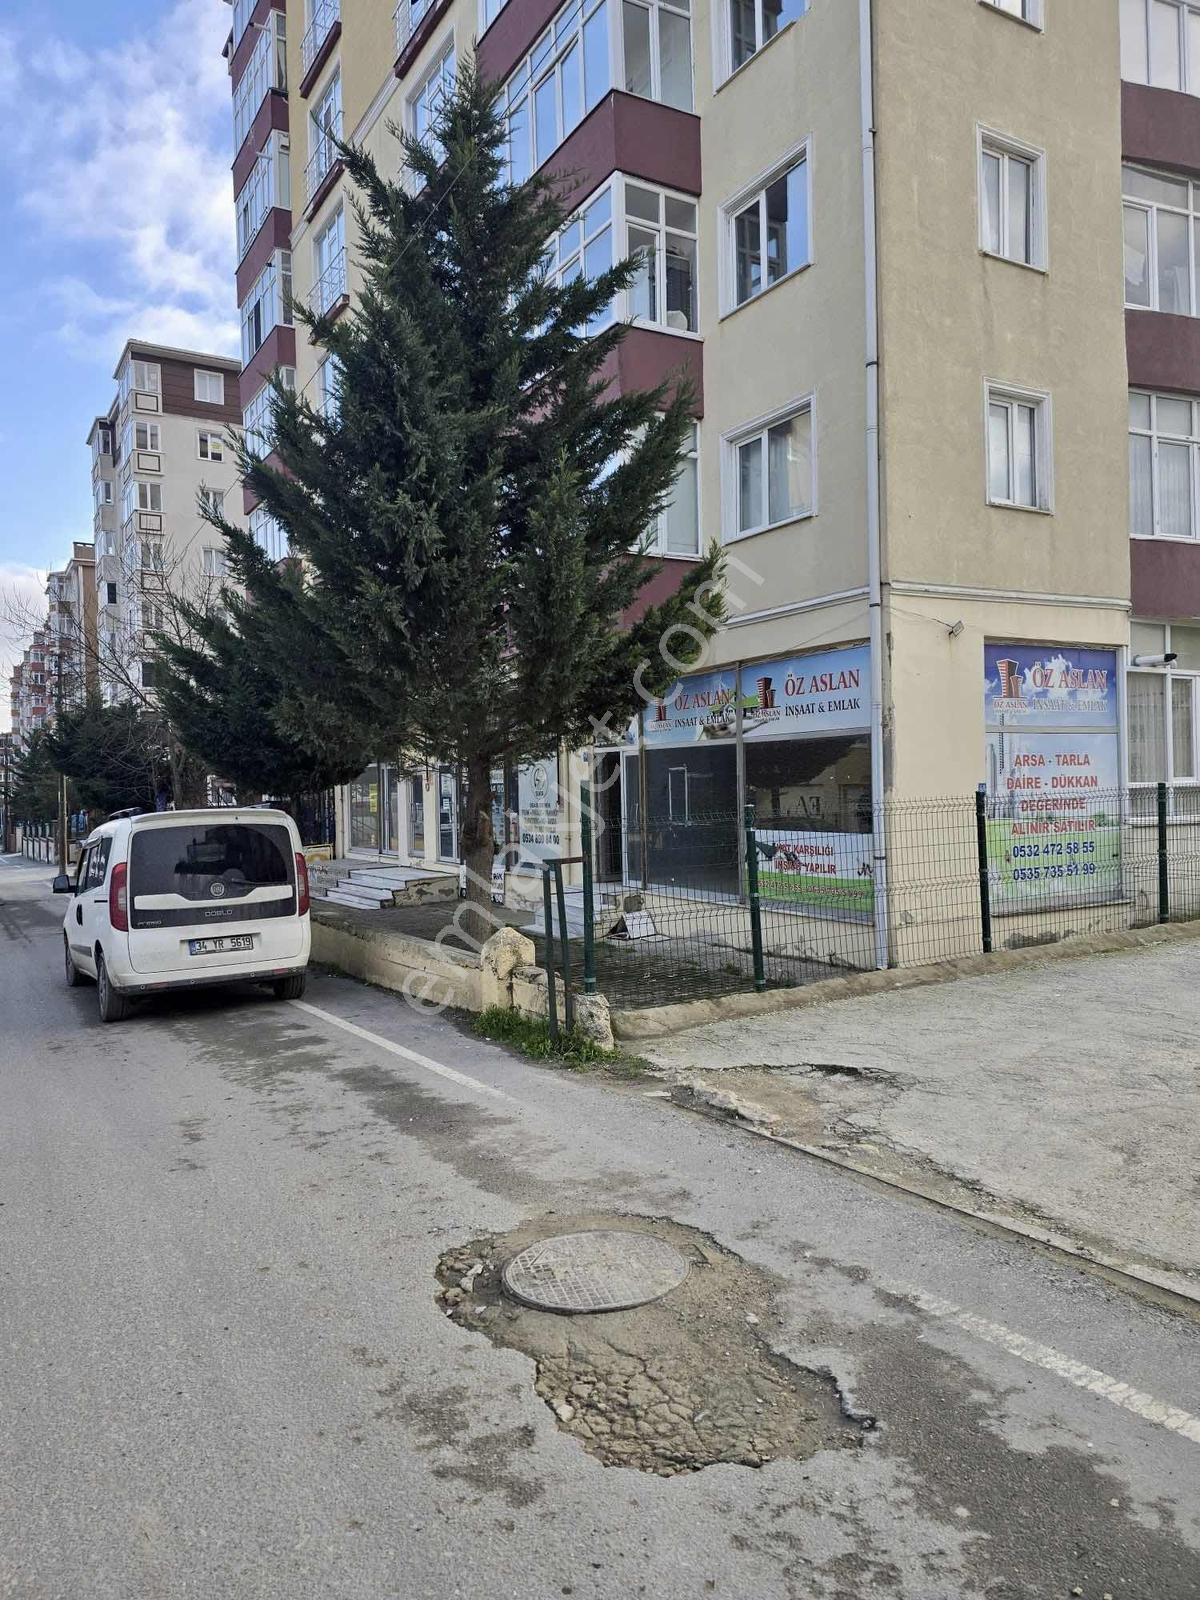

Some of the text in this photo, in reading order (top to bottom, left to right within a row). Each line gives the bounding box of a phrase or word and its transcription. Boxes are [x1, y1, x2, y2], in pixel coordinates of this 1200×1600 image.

[784, 669, 860, 696] ÖZ ASLAN
[1032, 662, 1107, 689] ÖZ ASLAN
[692, 688, 730, 708] ASLAN
[785, 698, 861, 718] İNŞAAT & EMLAK
[1014, 754, 1046, 767] ARSA
[1055, 754, 1090, 766] TARLA
[1006, 773, 1041, 790] DAİRE
[1051, 774, 1098, 789] DÜKKAN
[1011, 819, 1096, 836] ALINIR SATILIR
[1012, 841, 1095, 858] 0532 472 58 55
[805, 863, 837, 875] YAPILIR
[1013, 862, 1095, 880] 0535 735 51 99
[195, 936, 251, 951] 34 YR 5619
